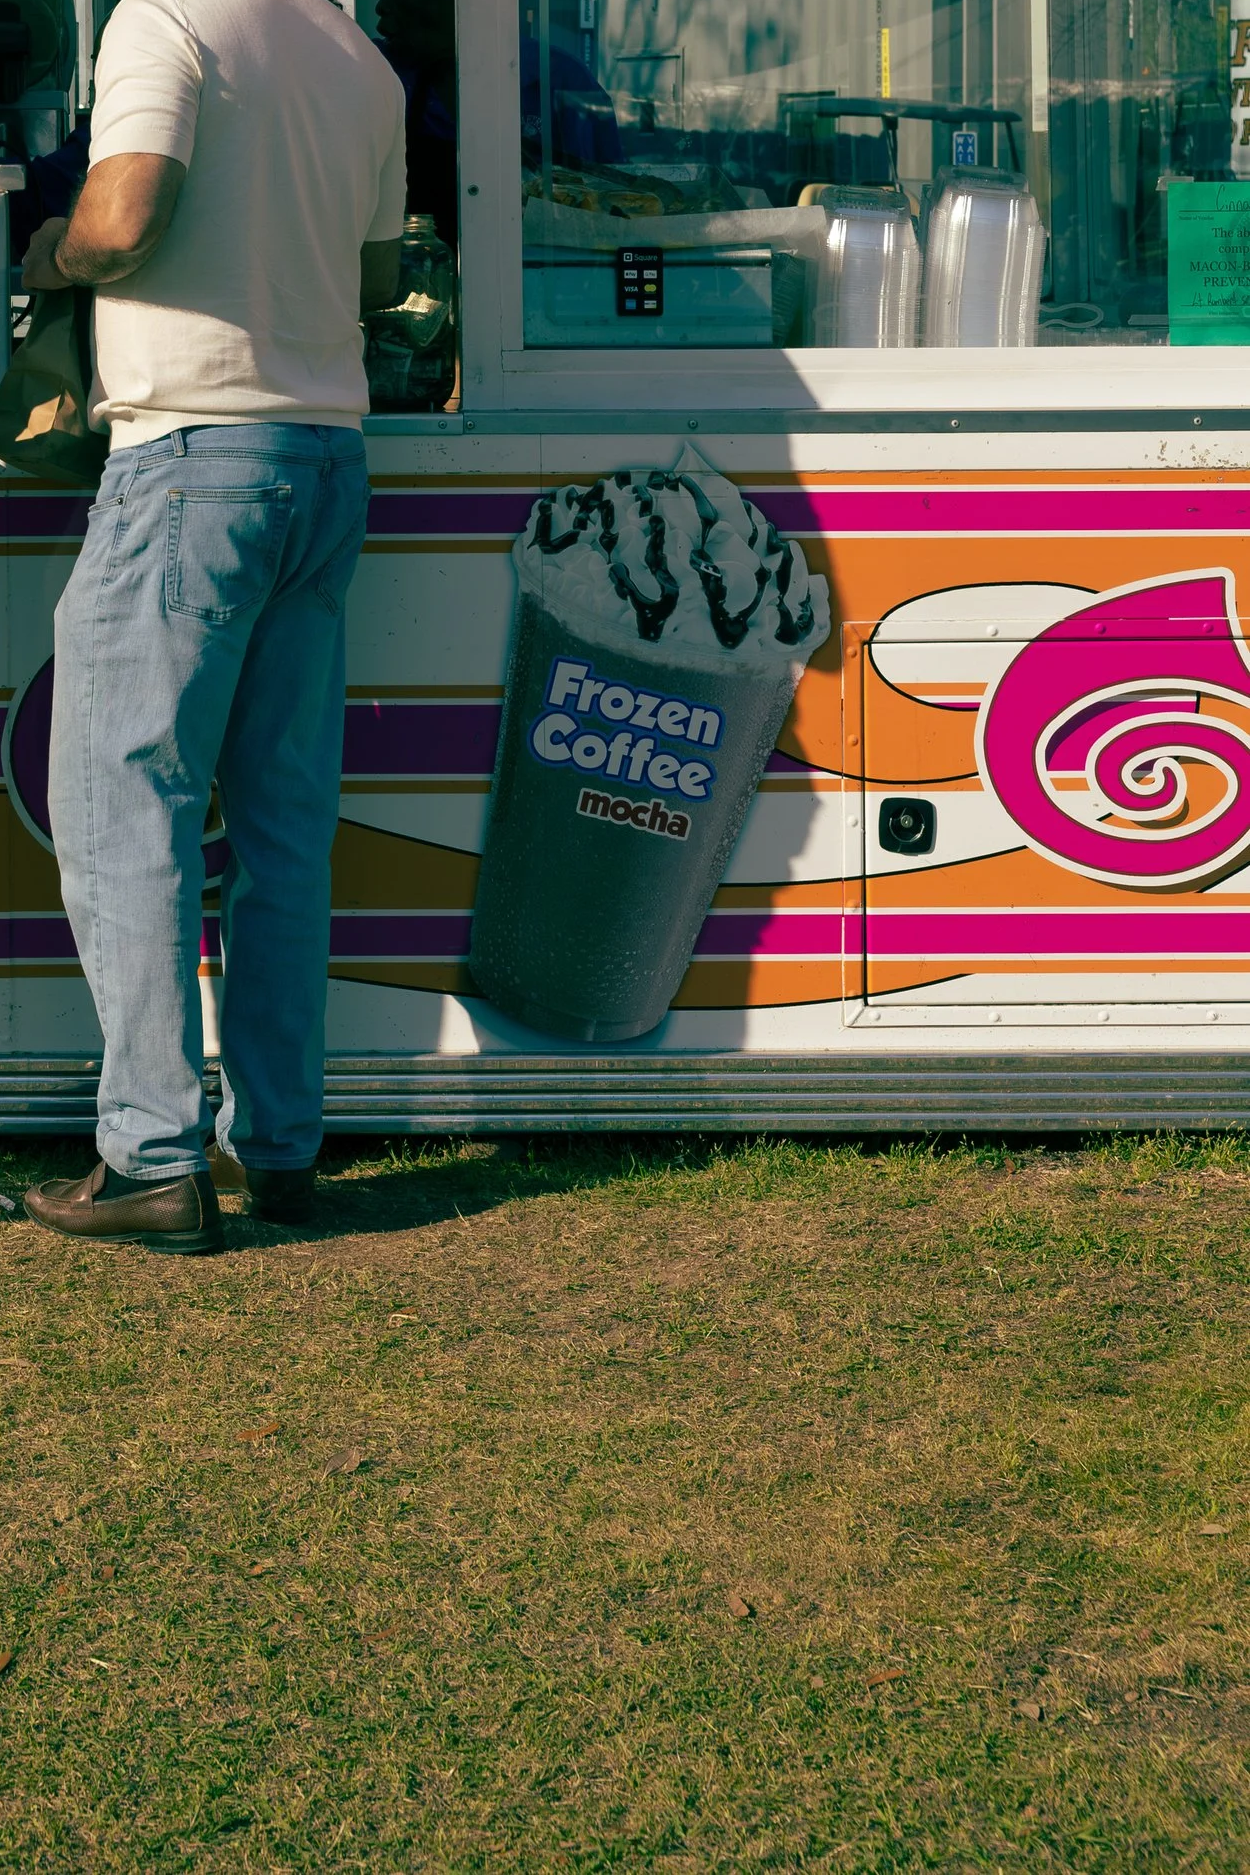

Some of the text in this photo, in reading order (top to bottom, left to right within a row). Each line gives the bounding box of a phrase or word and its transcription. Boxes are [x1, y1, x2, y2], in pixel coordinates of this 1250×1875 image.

[1212, 227, 1233, 239] The
[633, 253, 658, 262] Square
[1218, 245, 1250, 257] comp
[547, 659, 722, 747] Frozen
[531, 711, 713, 798] Coffee
[578, 788, 691, 839] mocha
